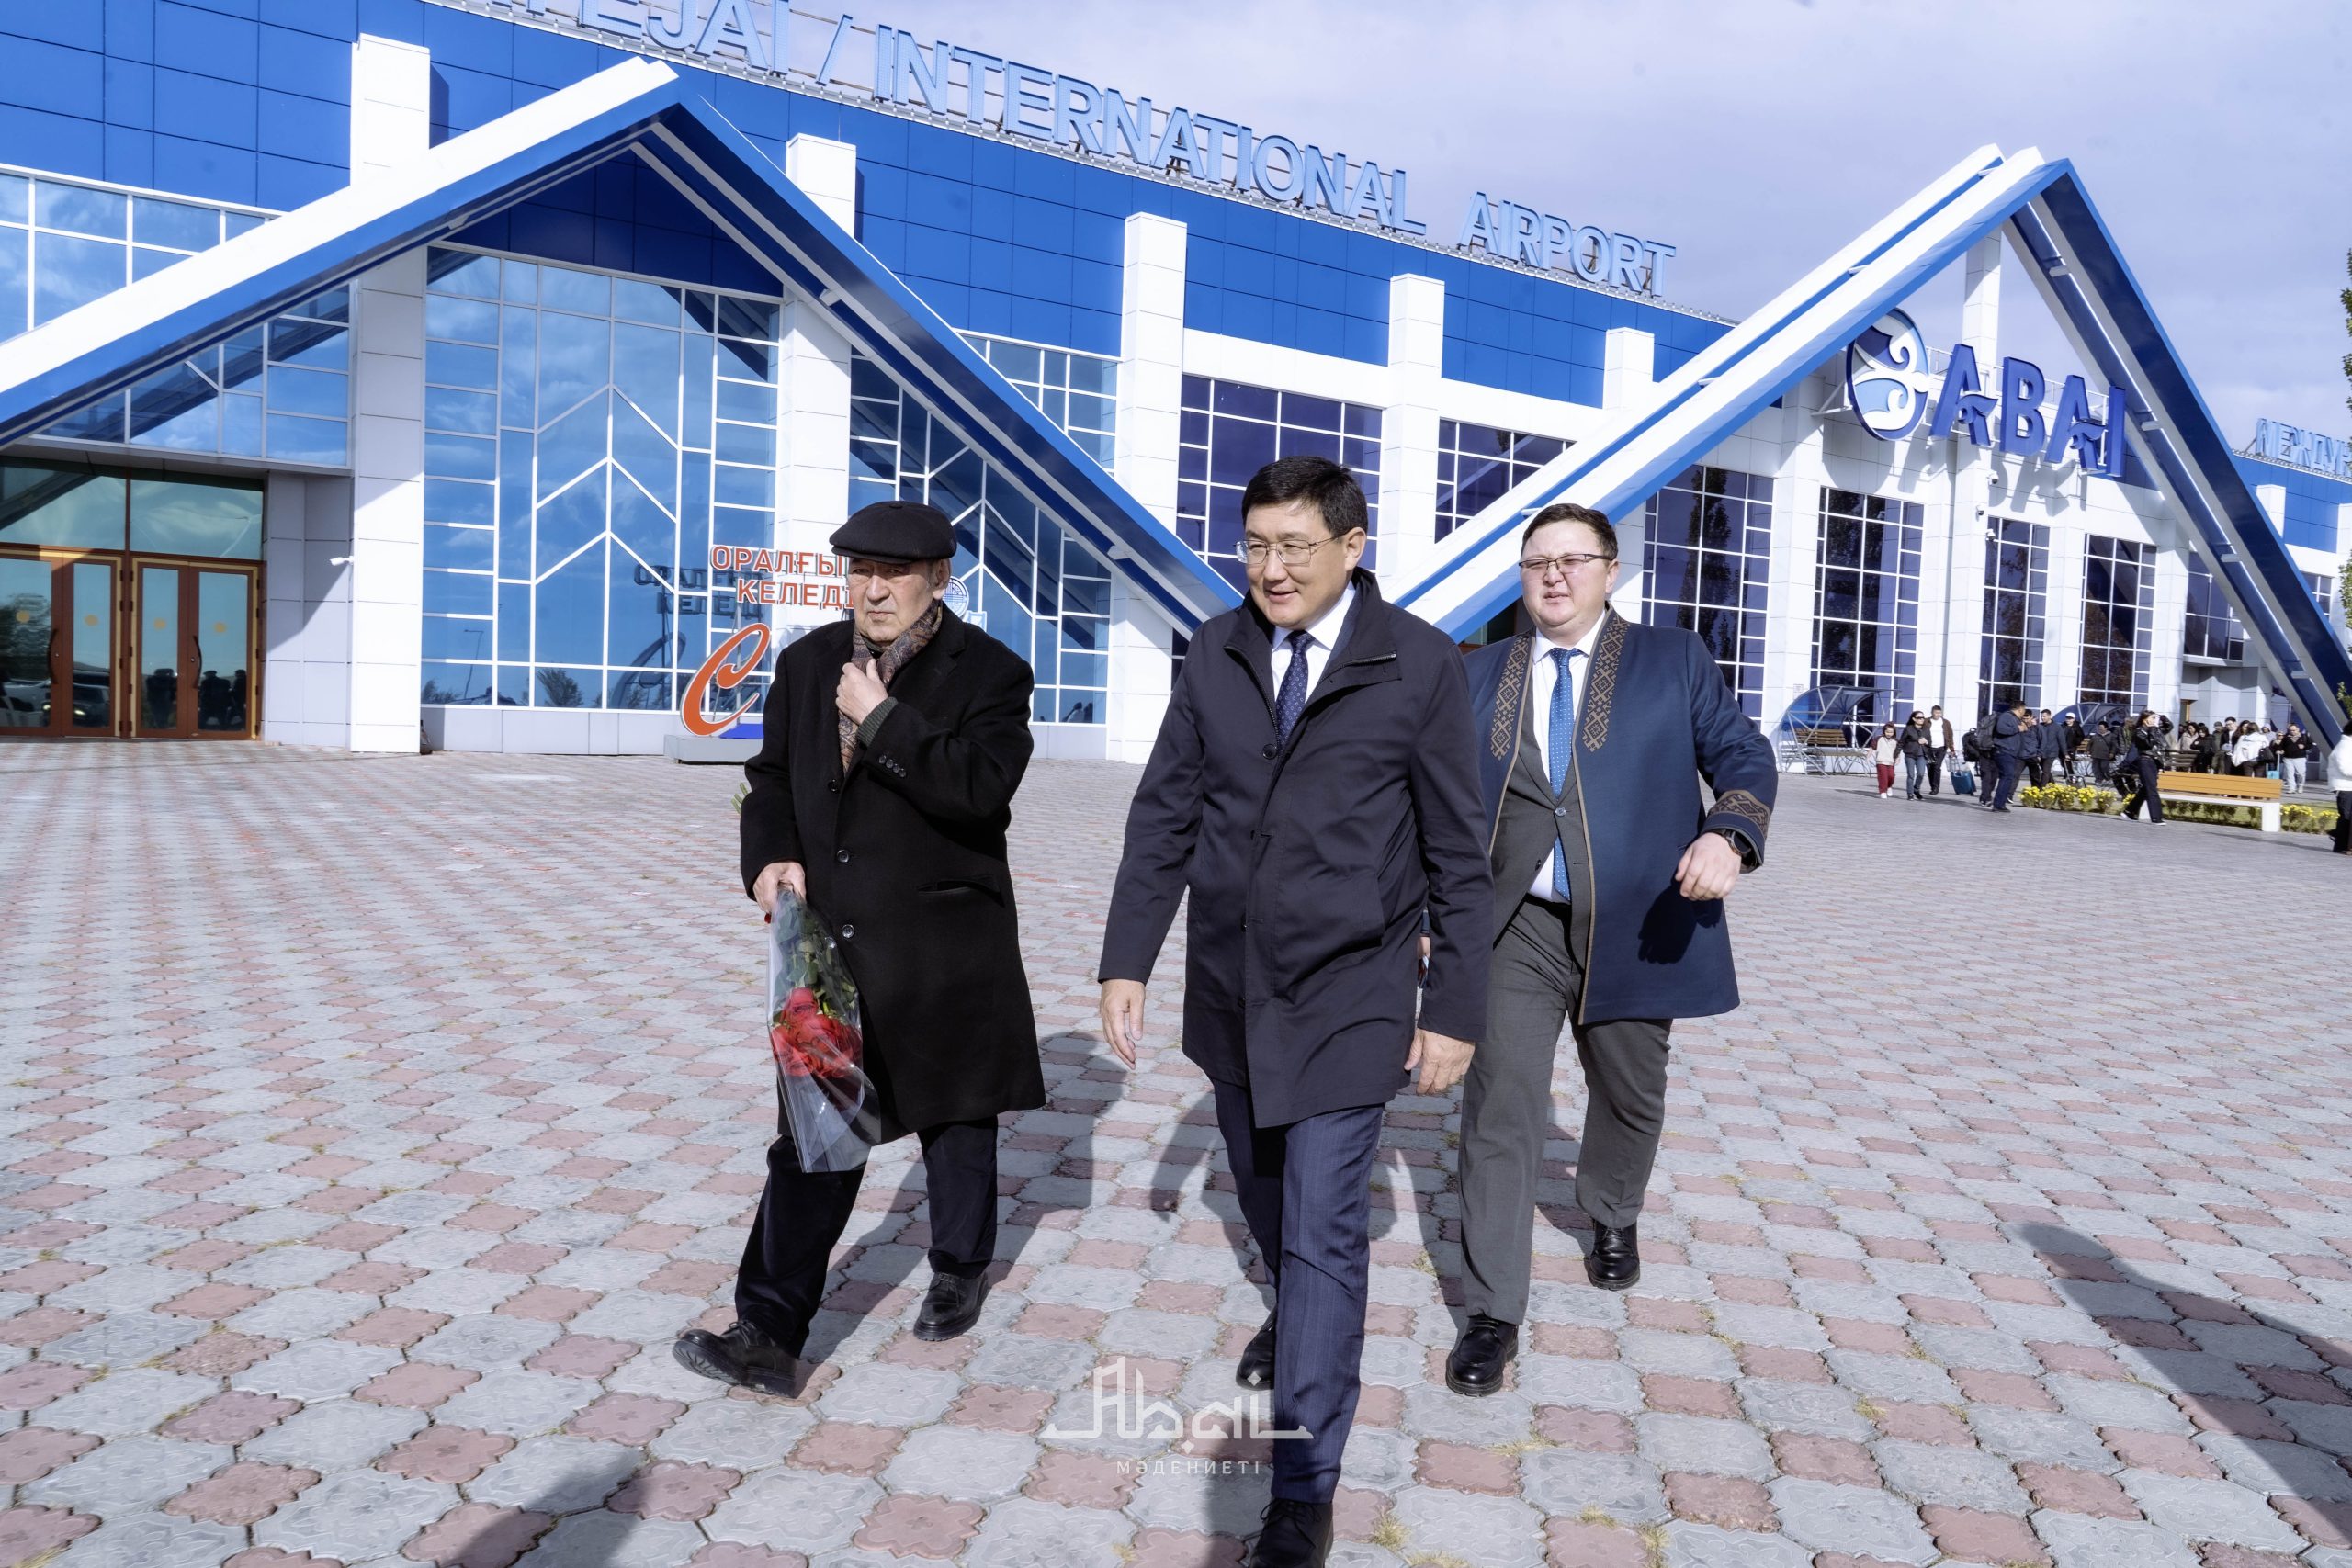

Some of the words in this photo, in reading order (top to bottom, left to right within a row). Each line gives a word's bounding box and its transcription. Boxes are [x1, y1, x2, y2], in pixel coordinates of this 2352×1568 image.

[874, 24, 1427, 236] INTERNATIONAL
[1458, 191, 1677, 297] AIRPORT
[1930, 344, 2127, 477] ABAI
